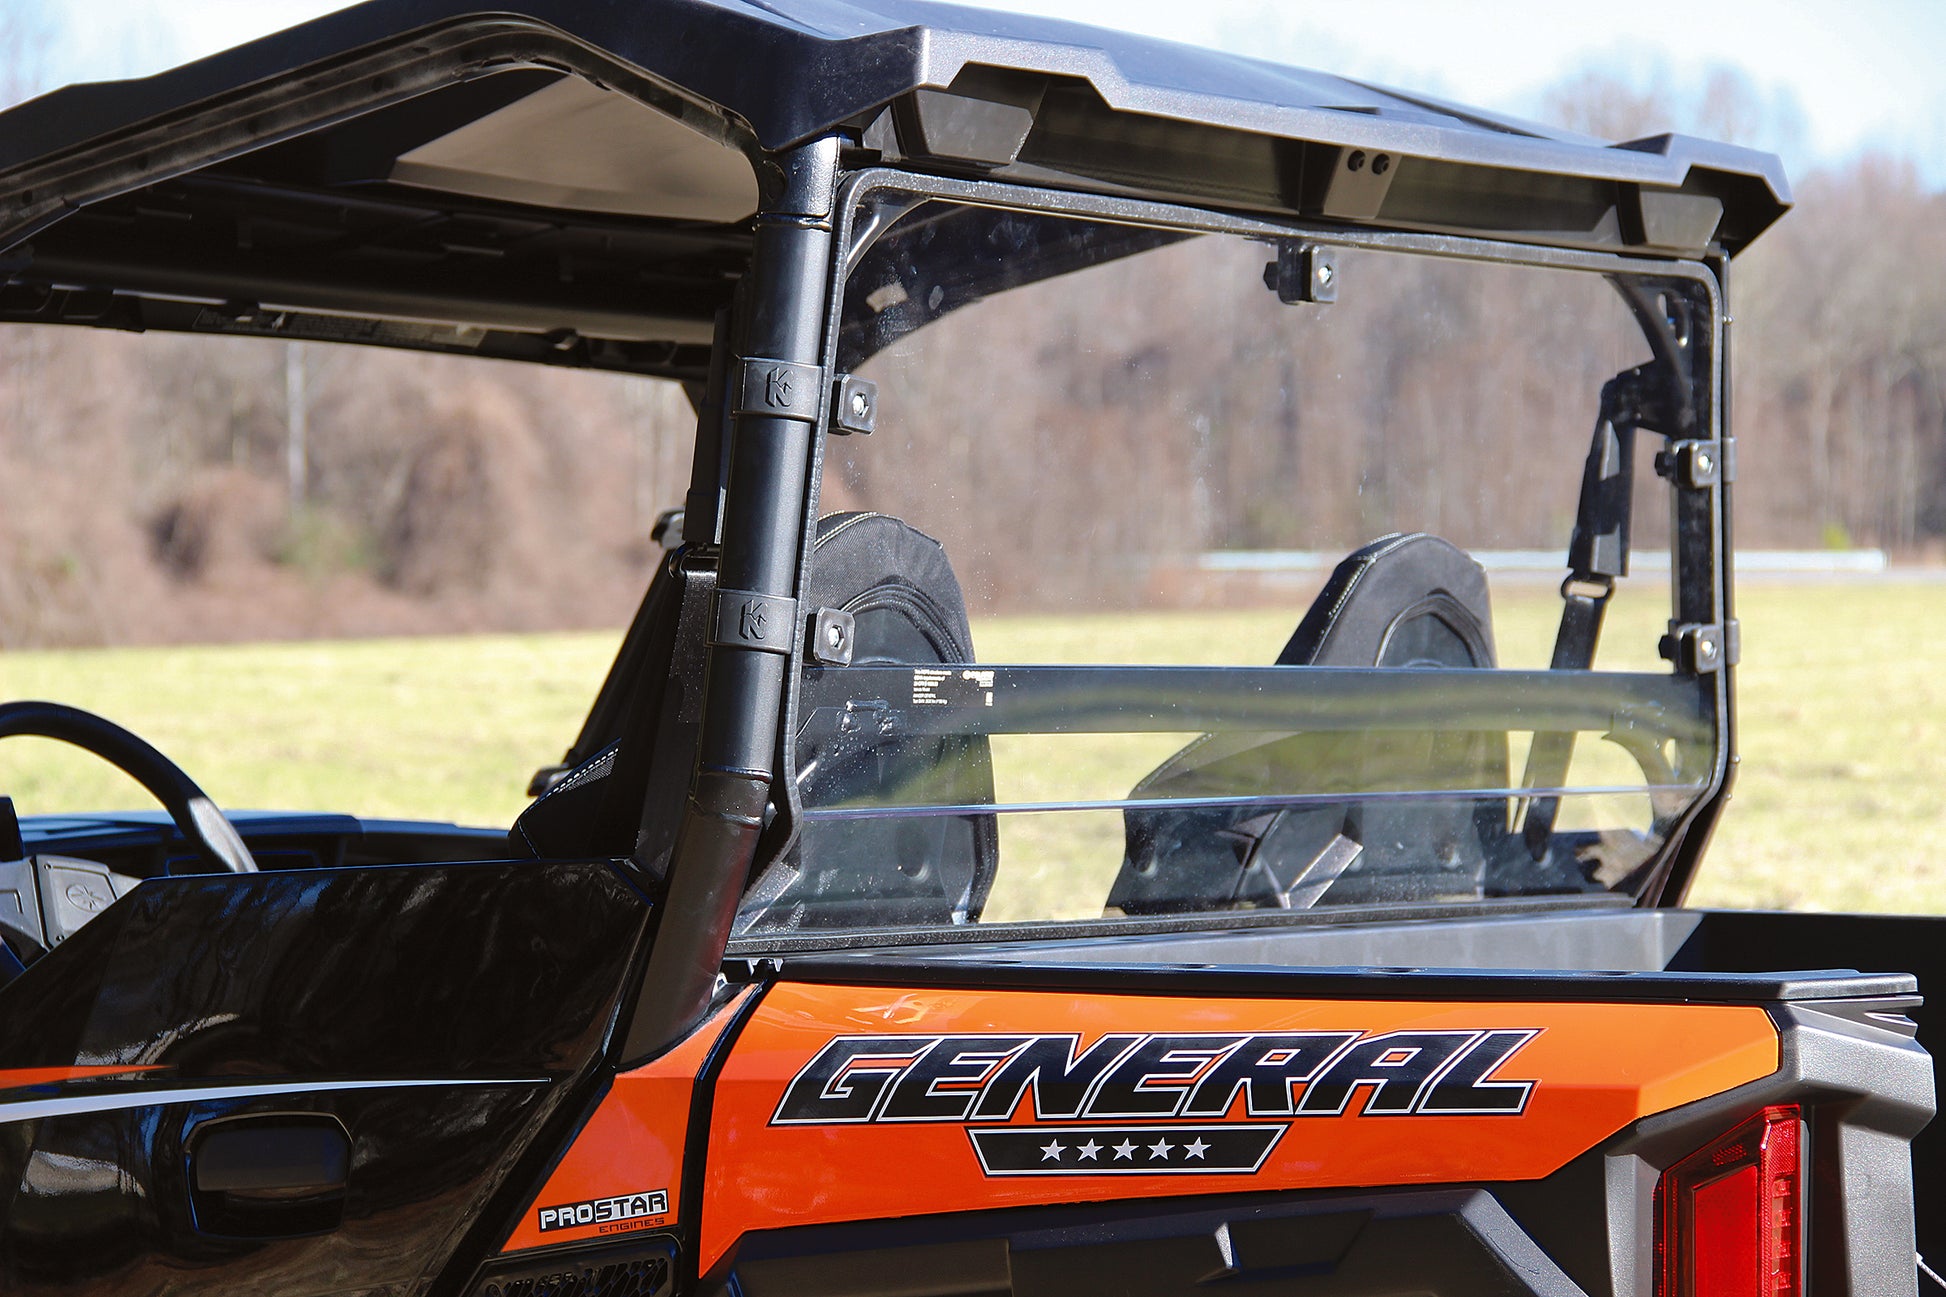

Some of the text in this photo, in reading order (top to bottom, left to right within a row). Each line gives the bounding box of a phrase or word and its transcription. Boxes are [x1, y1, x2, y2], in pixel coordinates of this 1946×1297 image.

[768, 1028, 1542, 1127] GENERAL
[540, 1190, 668, 1231] PROSTAR
[599, 1217, 665, 1234] ENGINES
